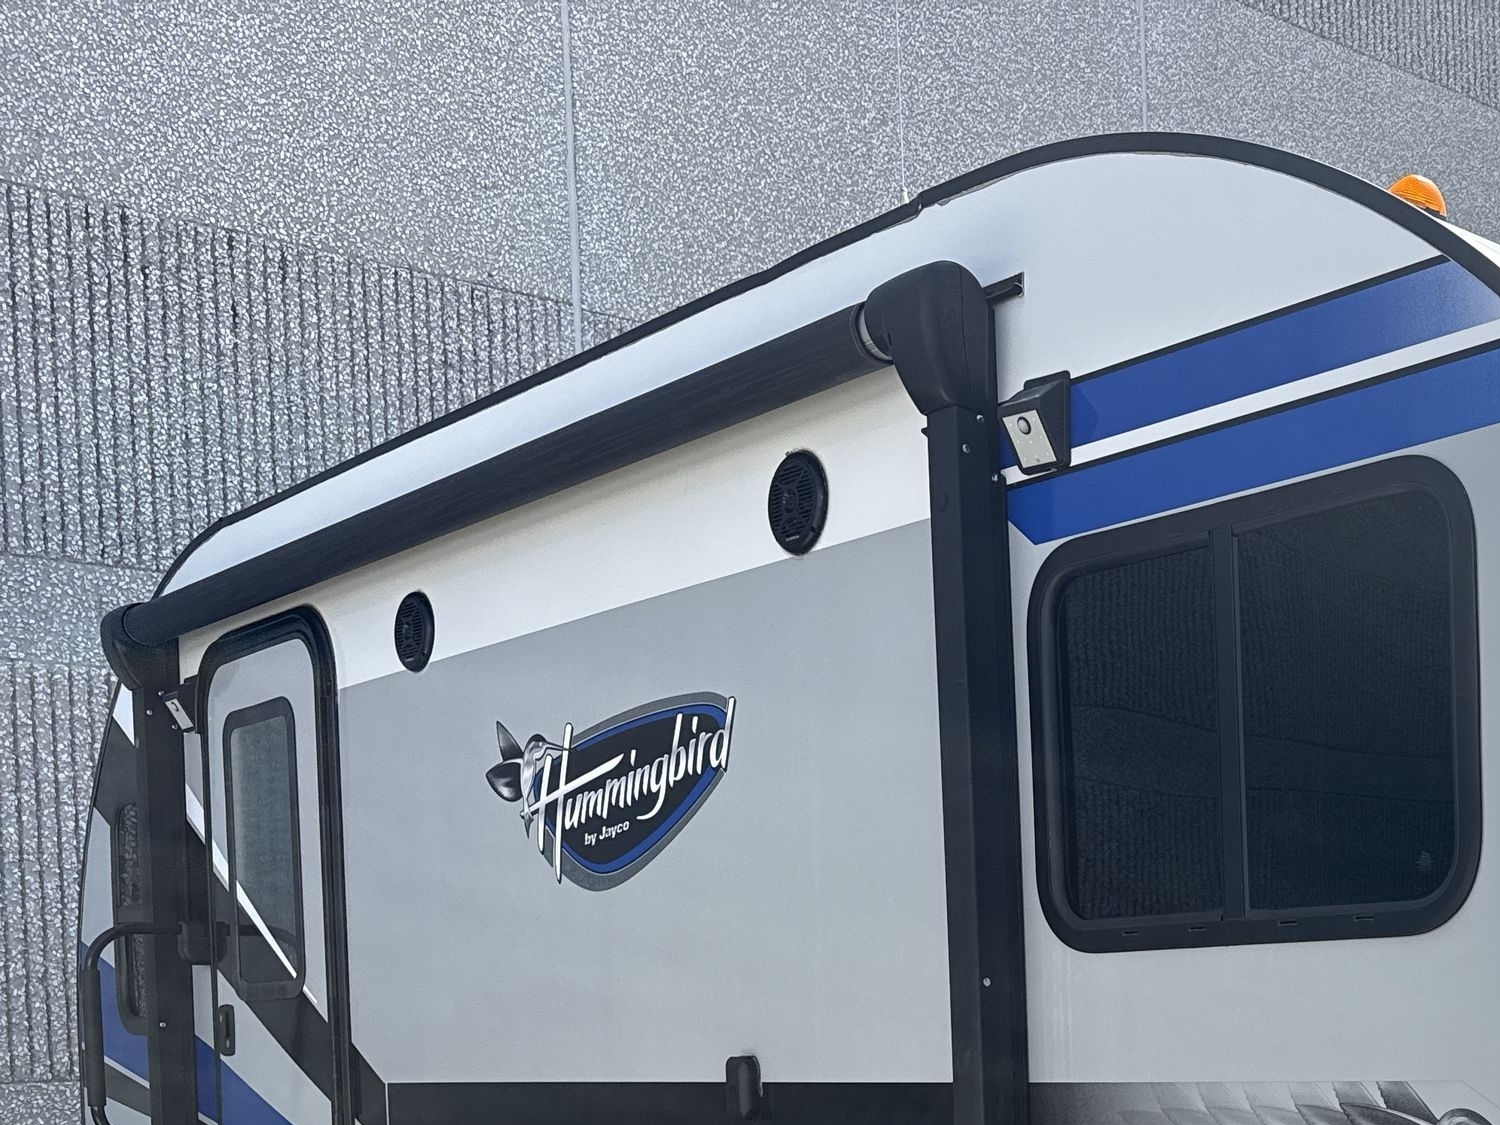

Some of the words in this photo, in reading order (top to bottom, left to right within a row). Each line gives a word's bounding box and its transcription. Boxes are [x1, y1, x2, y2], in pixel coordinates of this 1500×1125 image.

[520, 696, 737, 885] Hummingbird
[584, 832, 597, 846] by
[599, 820, 630, 839] Jayco
